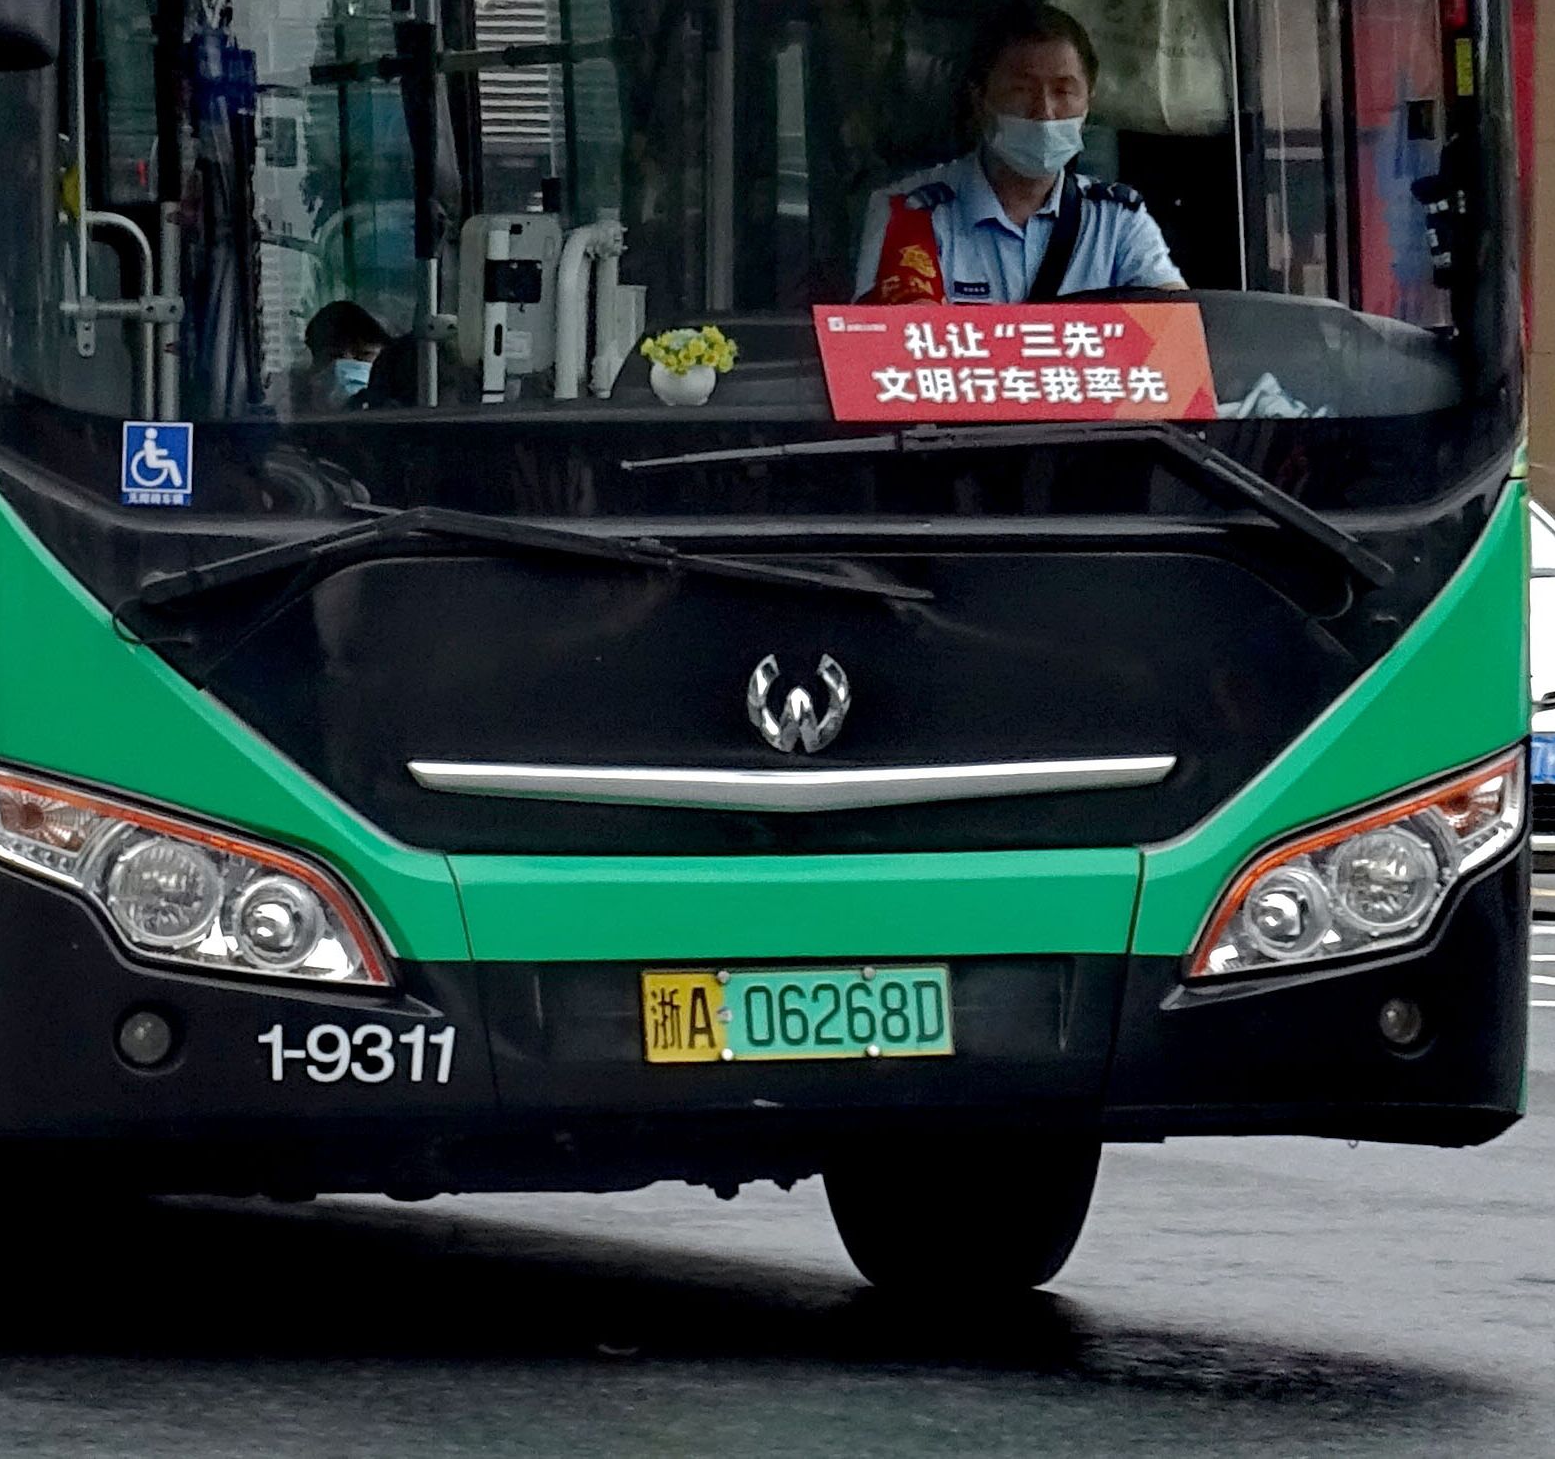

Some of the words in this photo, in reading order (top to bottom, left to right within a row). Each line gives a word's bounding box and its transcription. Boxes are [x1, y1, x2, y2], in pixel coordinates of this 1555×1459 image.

[871, 366, 1170, 404] 文明行车我率先
[258, 1023, 457, 1085] 1-9311
